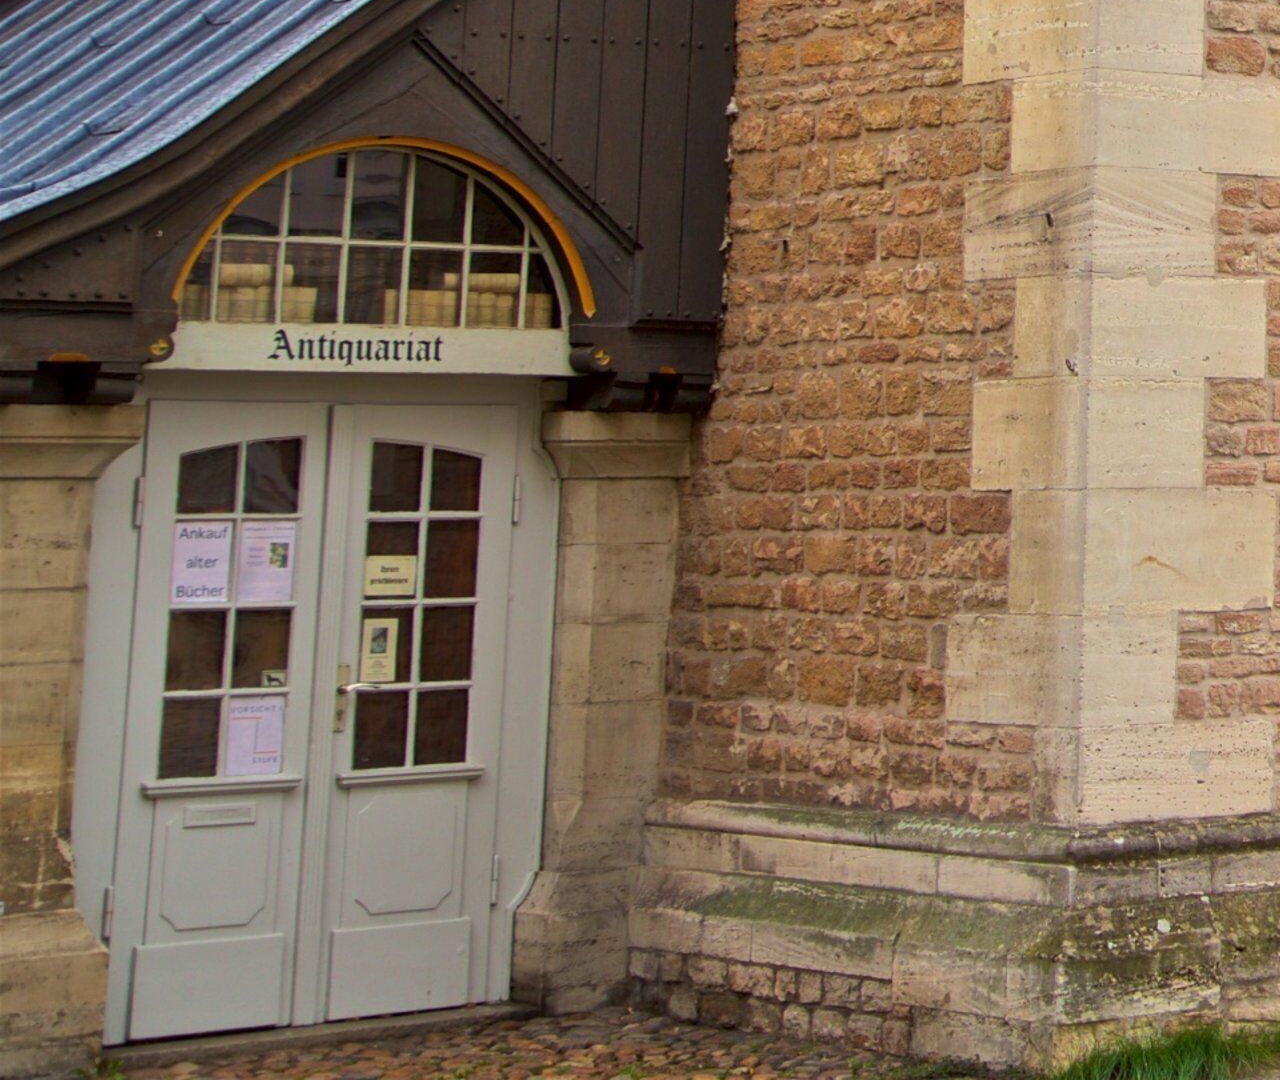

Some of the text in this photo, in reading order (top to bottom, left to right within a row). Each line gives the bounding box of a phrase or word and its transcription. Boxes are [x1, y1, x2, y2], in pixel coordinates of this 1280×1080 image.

[268, 328, 445, 367] Antiquariat
[179, 526, 229, 540] Ankauf
[185, 555, 219, 569] alter
[175, 584, 224, 599] Bücher
